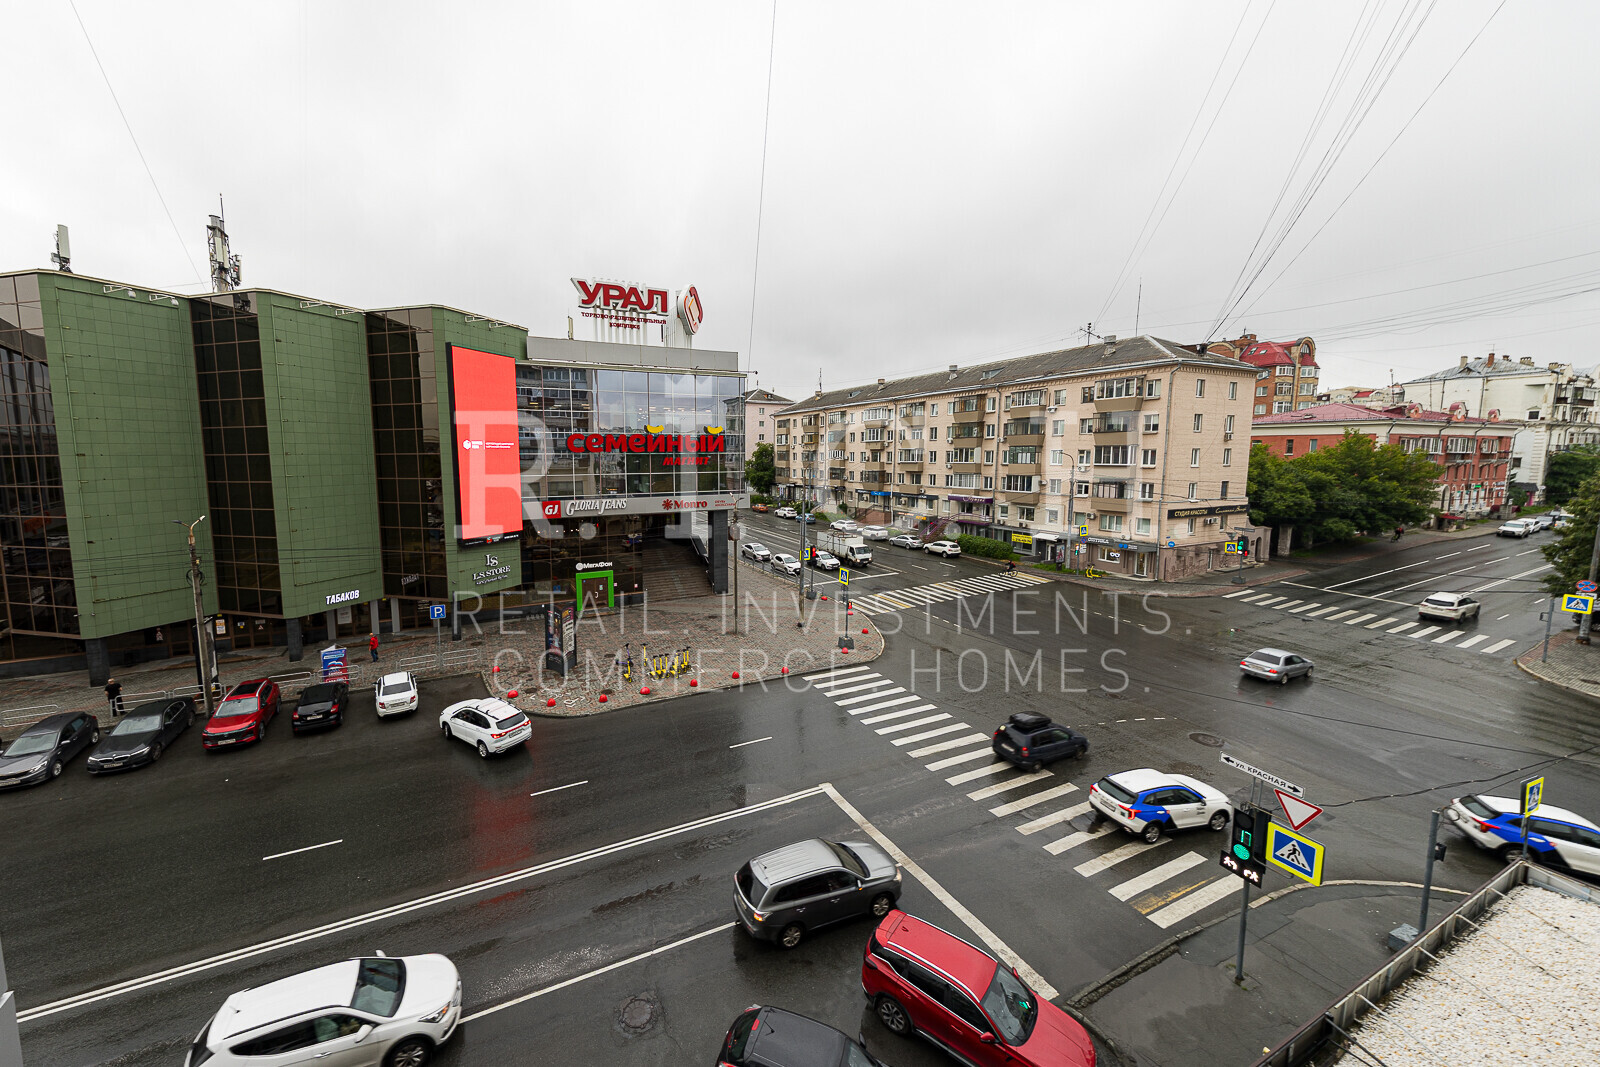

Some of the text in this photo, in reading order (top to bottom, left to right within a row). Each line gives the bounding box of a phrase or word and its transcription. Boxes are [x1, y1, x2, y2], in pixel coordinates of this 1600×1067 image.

[571, 278, 670, 316] УРАЛ
[544, 504, 559, 515] GJ
[597, 499, 627, 515] JEANS
[673, 499, 708, 510] Monro
[485, 565, 511, 577] STORE
[325, 589, 361, 605] ТАБАКОВ
[1247, 767, 1286, 788] КРАСНАЯ
